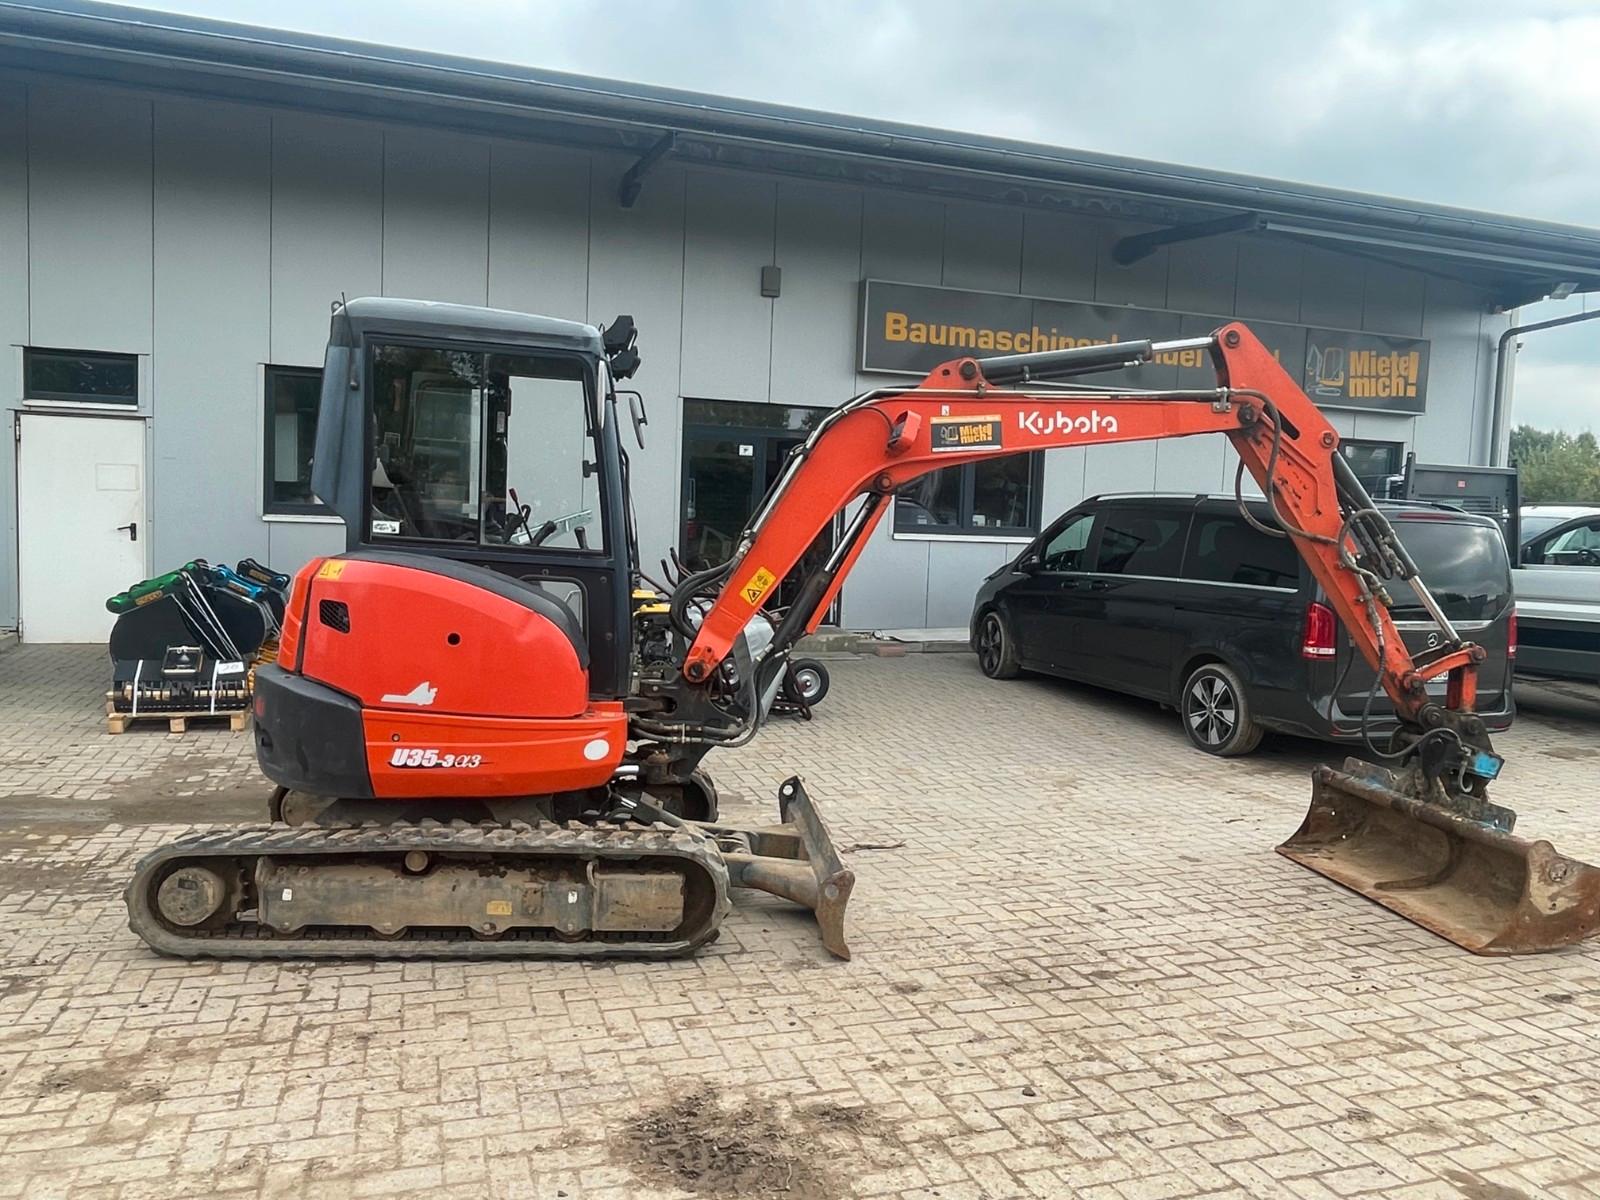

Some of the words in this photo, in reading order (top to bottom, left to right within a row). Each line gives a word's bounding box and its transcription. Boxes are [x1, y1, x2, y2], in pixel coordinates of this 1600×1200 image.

[885, 312, 1204, 369] Baumaschinel
[1349, 350, 1409, 376] Miete
[1018, 410, 1118, 435] Kubota
